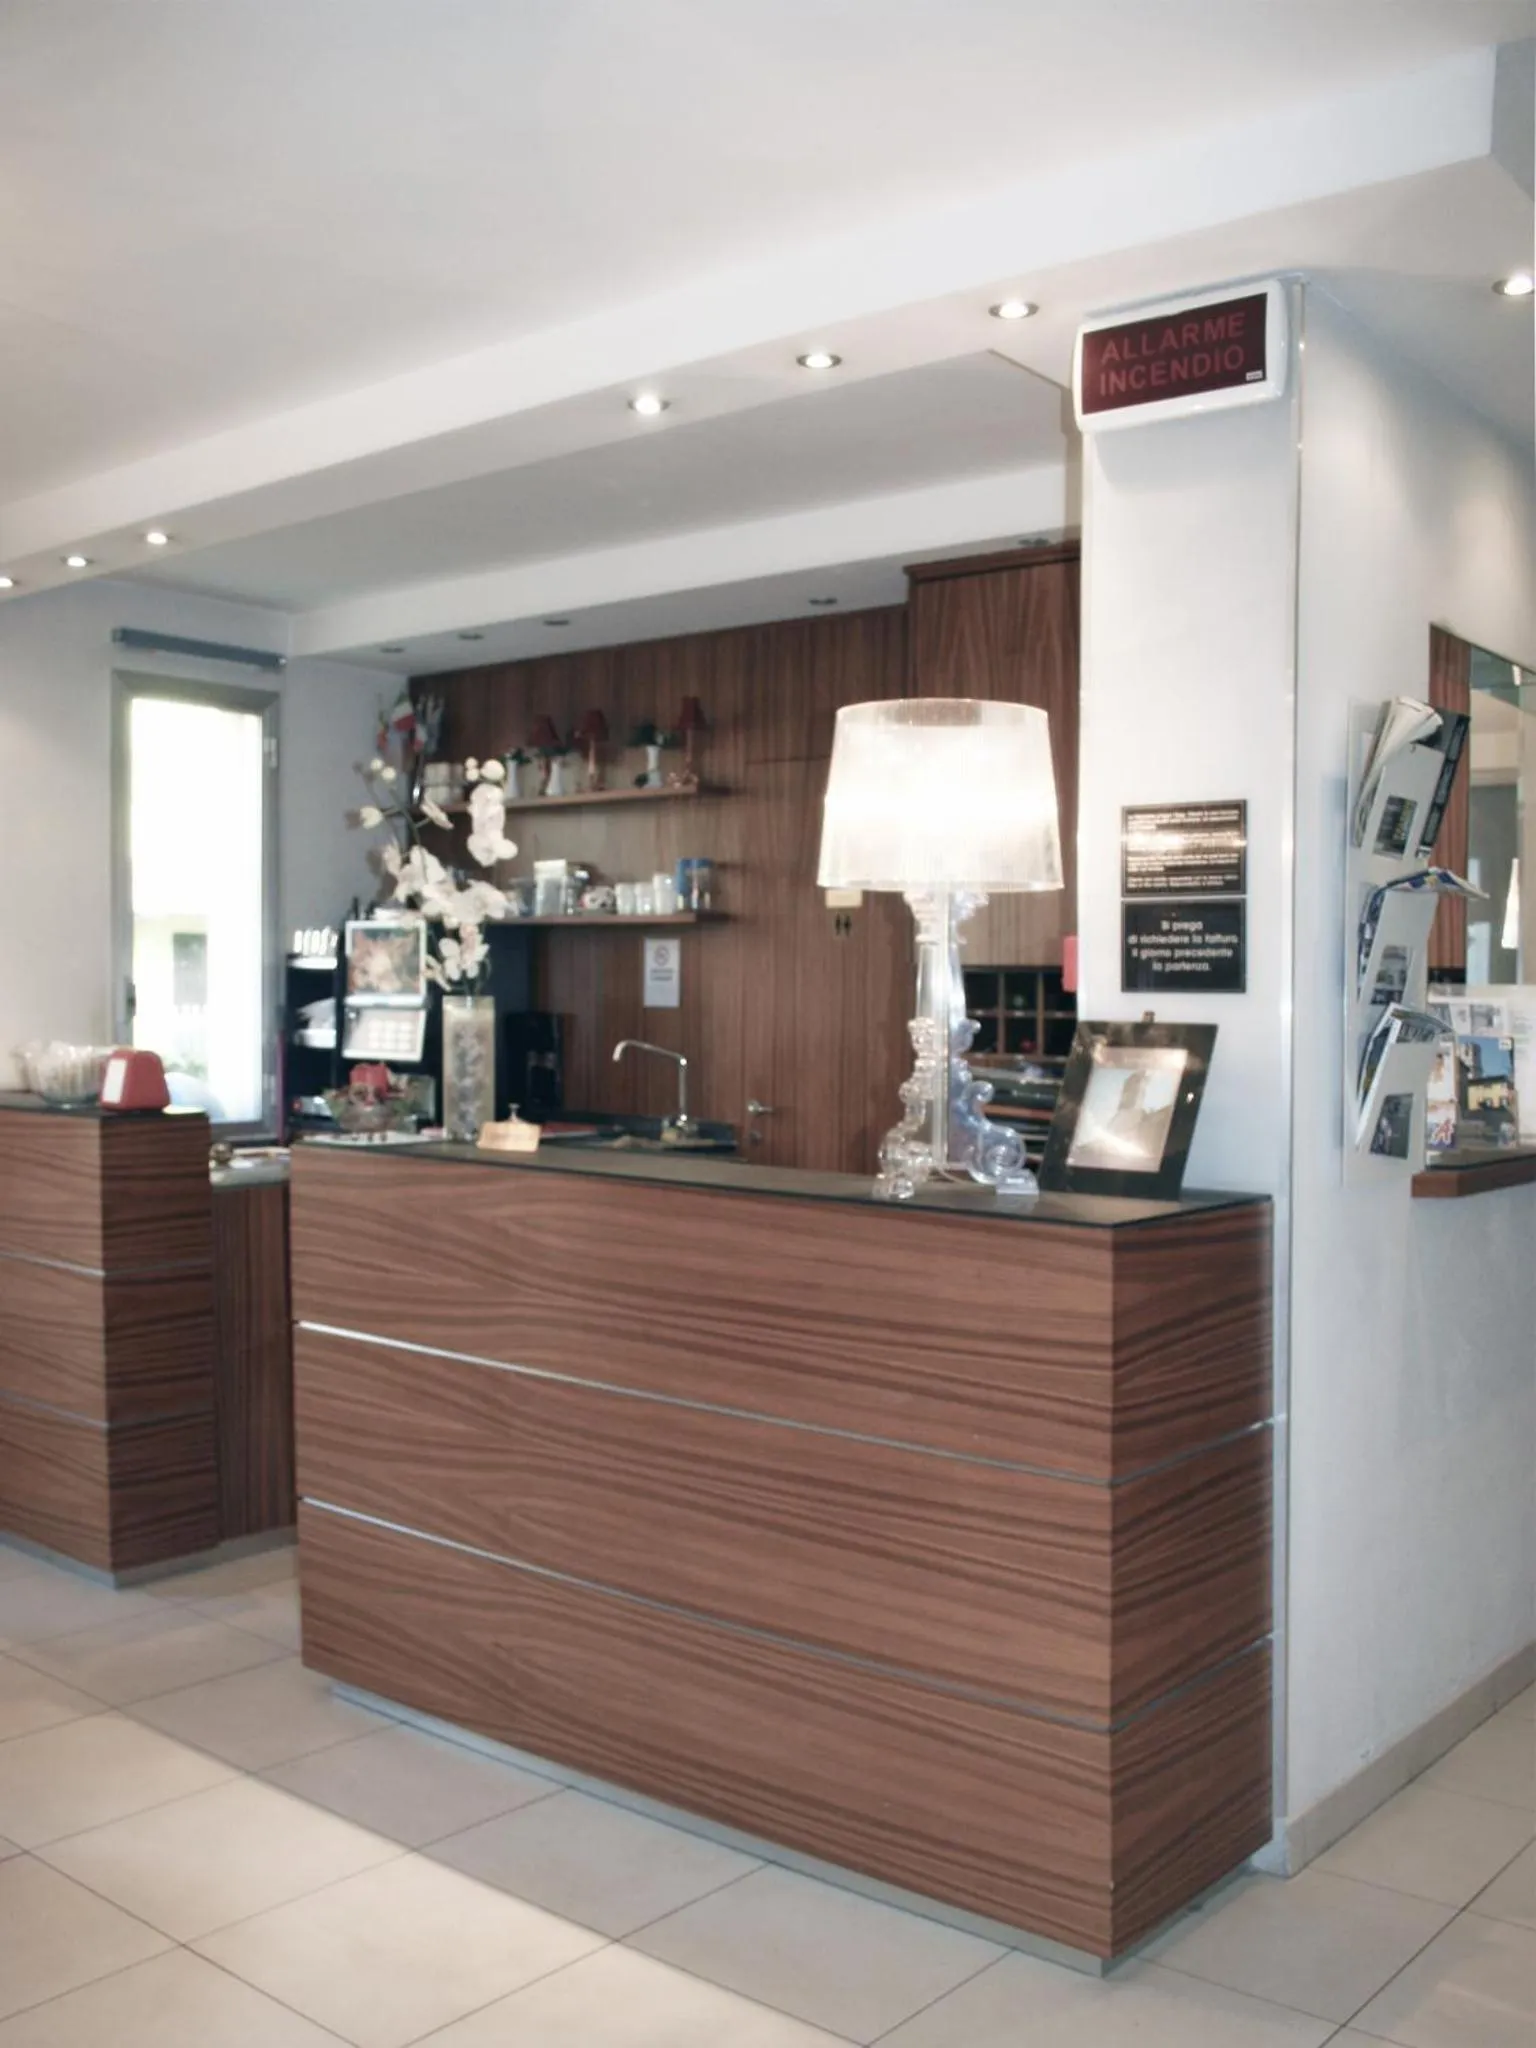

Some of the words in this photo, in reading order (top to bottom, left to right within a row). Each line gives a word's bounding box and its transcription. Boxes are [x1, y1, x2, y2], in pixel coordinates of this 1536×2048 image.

[1101, 312, 1246, 366] ALLARME
[1101, 344, 1244, 397] INCENDIO
[1172, 921, 1203, 932] prega
[1128, 934, 1138, 944] di
[1140, 934, 1190, 944] richiedere
[1192, 934, 1202, 944] la
[1204, 933, 1238, 944] fattura
[1140, 948, 1172, 960] giorno
[1173, 948, 1233, 958] precedente
[1152, 962, 1162, 971] la
